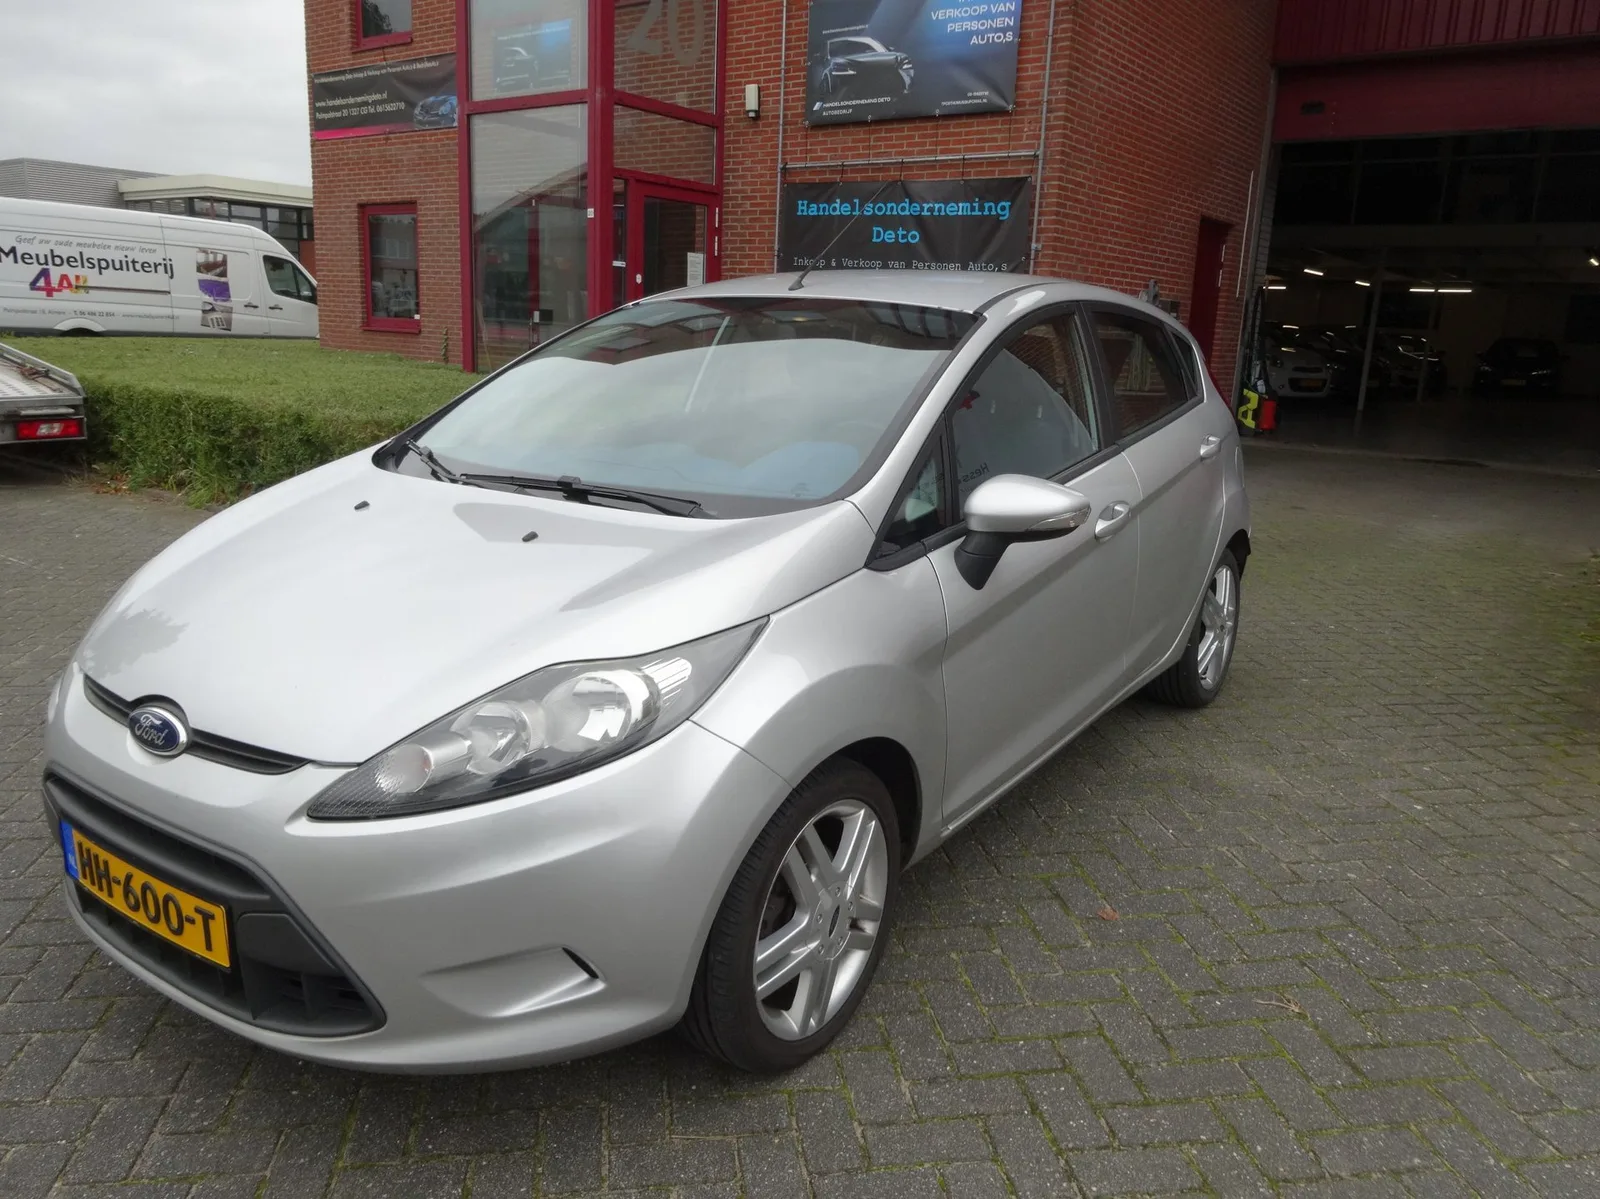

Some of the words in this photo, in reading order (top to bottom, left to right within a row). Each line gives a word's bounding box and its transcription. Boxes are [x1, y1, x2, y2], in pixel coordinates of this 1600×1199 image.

[931, 5, 988, 20] VERKOOP
[990, 2, 1015, 13] VAN
[947, 16, 1014, 33] PERSONEN
[970, 31, 1013, 45] AUTO,S
[796, 199, 1012, 220] Handelsonderneming
[15, 235, 35, 245] Geef
[76, 241, 112, 250] meubelen
[114, 244, 136, 252] nieuw
[872, 227, 920, 244] Deto
[0, 245, 175, 279] Meubelspuiterij
[831, 258, 836, 267] &
[842, 258, 882, 270] Verkoop
[888, 260, 905, 269] van
[912, 260, 961, 271] Personen
[968, 261, 1007, 272] Auto,s
[134, 713, 166, 747] Ford
[77, 840, 215, 951] HH-600-T
